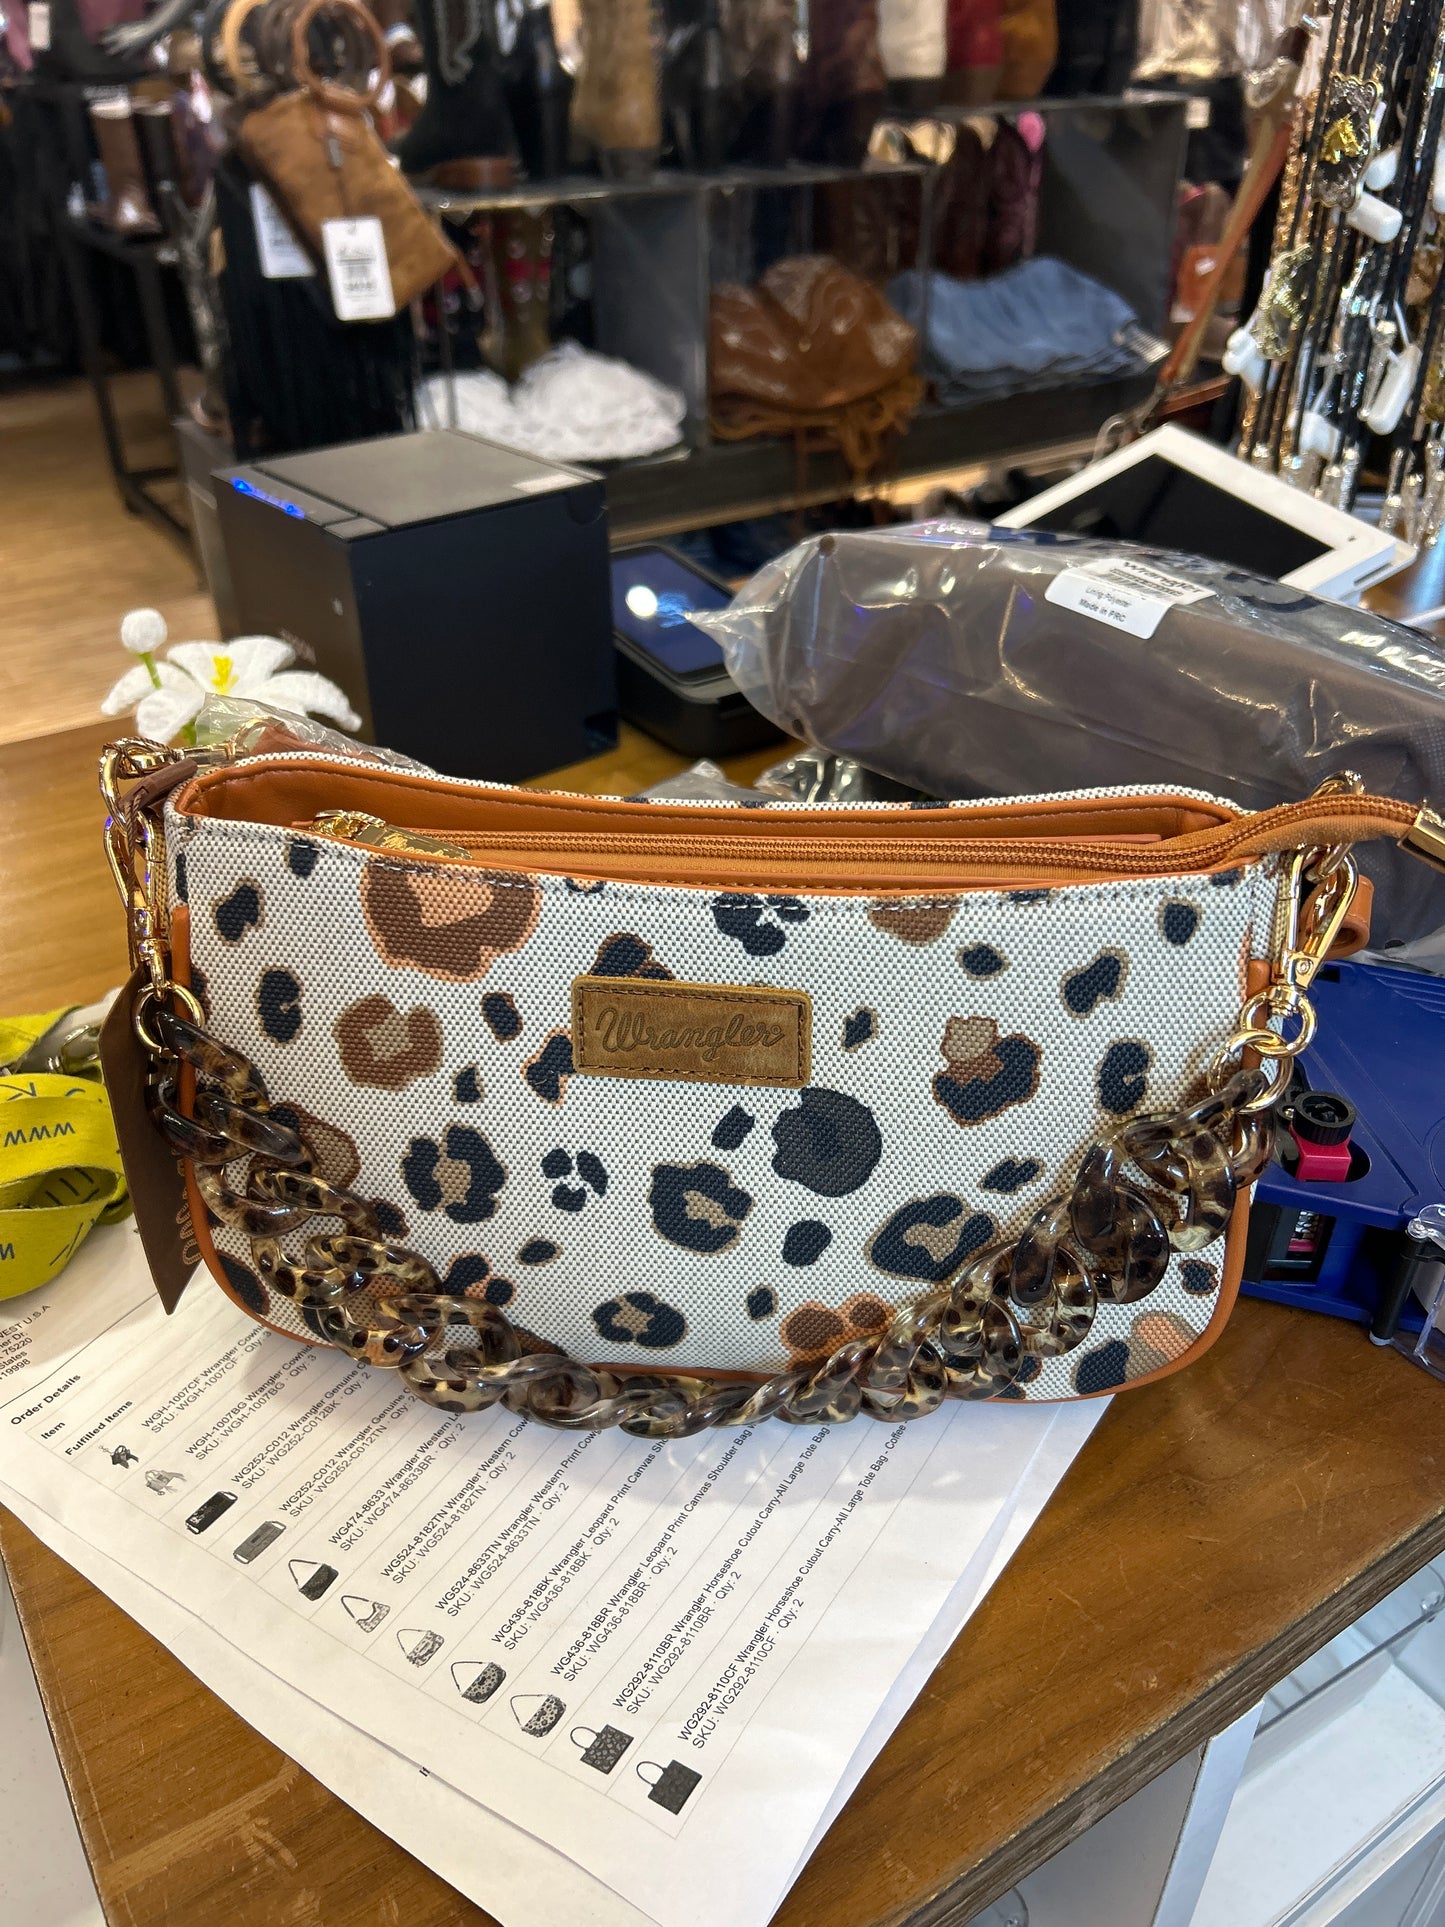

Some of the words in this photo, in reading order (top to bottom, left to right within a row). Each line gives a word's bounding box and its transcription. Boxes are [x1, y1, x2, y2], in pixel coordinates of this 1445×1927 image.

[595, 1007, 785, 1063] Wrangler
[0, 1351, 27, 1370] States
[2, 1337, 33, 1355] 75220
[12, 1332, 28, 1341] Dr.
[141, 1377, 201, 1429] WGH-1007CF
[200, 1346, 239, 1383] Wrangler
[152, 1413, 179, 1434] SKU:
[177, 1357, 240, 1412] WGH-1007CF
[244, 1339, 264, 1354] Qty:
[10, 1402, 45, 1426] Order
[43, 1373, 81, 1404] Details
[41, 1420, 66, 1441] Item
[65, 1421, 106, 1456] Fulfilled
[105, 1400, 133, 1425] Items
[186, 1402, 248, 1456] WGH-1007BG
[245, 1370, 284, 1404] Wrangler
[195, 1437, 224, 1461] SKU:
[223, 1381, 286, 1437] WGH-1007BG
[289, 1363, 309, 1378] Qty:
[231, 1431, 290, 1484] WG252-C012
[287, 1396, 327, 1434] Wrangler
[324, 1368, 359, 1400] Genuine
[241, 1466, 271, 1489] SKU:
[267, 1399, 341, 1465] WG252-C012BK
[344, 1379, 364, 1397] Qty:
[279, 1458, 338, 1512] WG252-C012
[335, 1423, 374, 1460] Wrangler
[371, 1394, 406, 1425] Genuine
[289, 1494, 318, 1518] SKU:
[314, 1424, 388, 1493] WG252-C012TN
[390, 1402, 411, 1420] Qty:
[328, 1486, 386, 1545] WG474-8633
[382, 1450, 421, 1490] Wrangler
[417, 1421, 452, 1456] Western
[340, 1525, 368, 1552] SKU:
[364, 1454, 436, 1526] WG474-8633BR
[438, 1429, 459, 1450] Qty:
[381, 1507, 448, 1578] WG524-8182TN
[444, 1472, 483, 1510] Wrangler
[478, 1437, 513, 1473] Western
[392, 1559, 421, 1585] SKU:
[416, 1484, 487, 1559] WG524-8182TN
[489, 1459, 510, 1480] Qty:
[435, 1538, 502, 1611] WG524-8633TN
[498, 1502, 536, 1541] Wrangler
[531, 1465, 565, 1503] Western
[560, 1448, 582, 1469] Print
[447, 1590, 476, 1618] SKU:
[471, 1515, 542, 1590] WG524-8633TN
[542, 1490, 563, 1511] Qty:
[491, 1576, 553, 1644] WG436-818BK
[549, 1536, 587, 1577] Wrangler
[581, 1502, 616, 1539] Leopard
[611, 1481, 631, 1504] Print
[627, 1452, 656, 1484] Canvas
[550, 1606, 611, 1676] WG436-818BR
[606, 1566, 644, 1608] Wrangler
[639, 1529, 672, 1568] Leopard
[667, 1510, 689, 1532] Print
[684, 1478, 713, 1513] Canvas
[707, 1443, 738, 1481] Shoulder
[733, 1429, 753, 1446] Bag
[612, 1629, 677, 1709] WG292-8110BR
[672, 1585, 708, 1632] Wrangler
[704, 1547, 743, 1593] Horseshoe
[737, 1517, 764, 1548] Cutout
[758, 1480, 790, 1521] Carry-All
[785, 1460, 806, 1487] Large
[800, 1444, 818, 1461] Tote
[811, 1426, 830, 1444] Bag
[504, 1621, 534, 1651] SKU:
[528, 1550, 592, 1623] WG436-818BK
[592, 1524, 613, 1546] Qty:
[563, 1653, 593, 1683] SKU:
[586, 1580, 651, 1654] WG436-818BR
[650, 1554, 672, 1576] Qty:
[678, 1662, 738, 1742] WG292-8110CF
[733, 1616, 769, 1664] Wrangler
[765, 1576, 803, 1625] Horseshoe
[798, 1546, 824, 1578] Cutout
[819, 1510, 849, 1551] Carry-All
[844, 1487, 865, 1517] Large
[858, 1470, 877, 1490] Tote
[870, 1455, 889, 1473] Bag
[884, 1424, 907, 1450] Coffee
[627, 1684, 656, 1715] SKU:
[648, 1606, 715, 1686] WG292-8110BR
[715, 1580, 738, 1608] Qty:
[692, 1716, 722, 1750] SKU:
[713, 1636, 776, 1717] WG292-8110CF
[777, 1607, 801, 1634] Qty:
